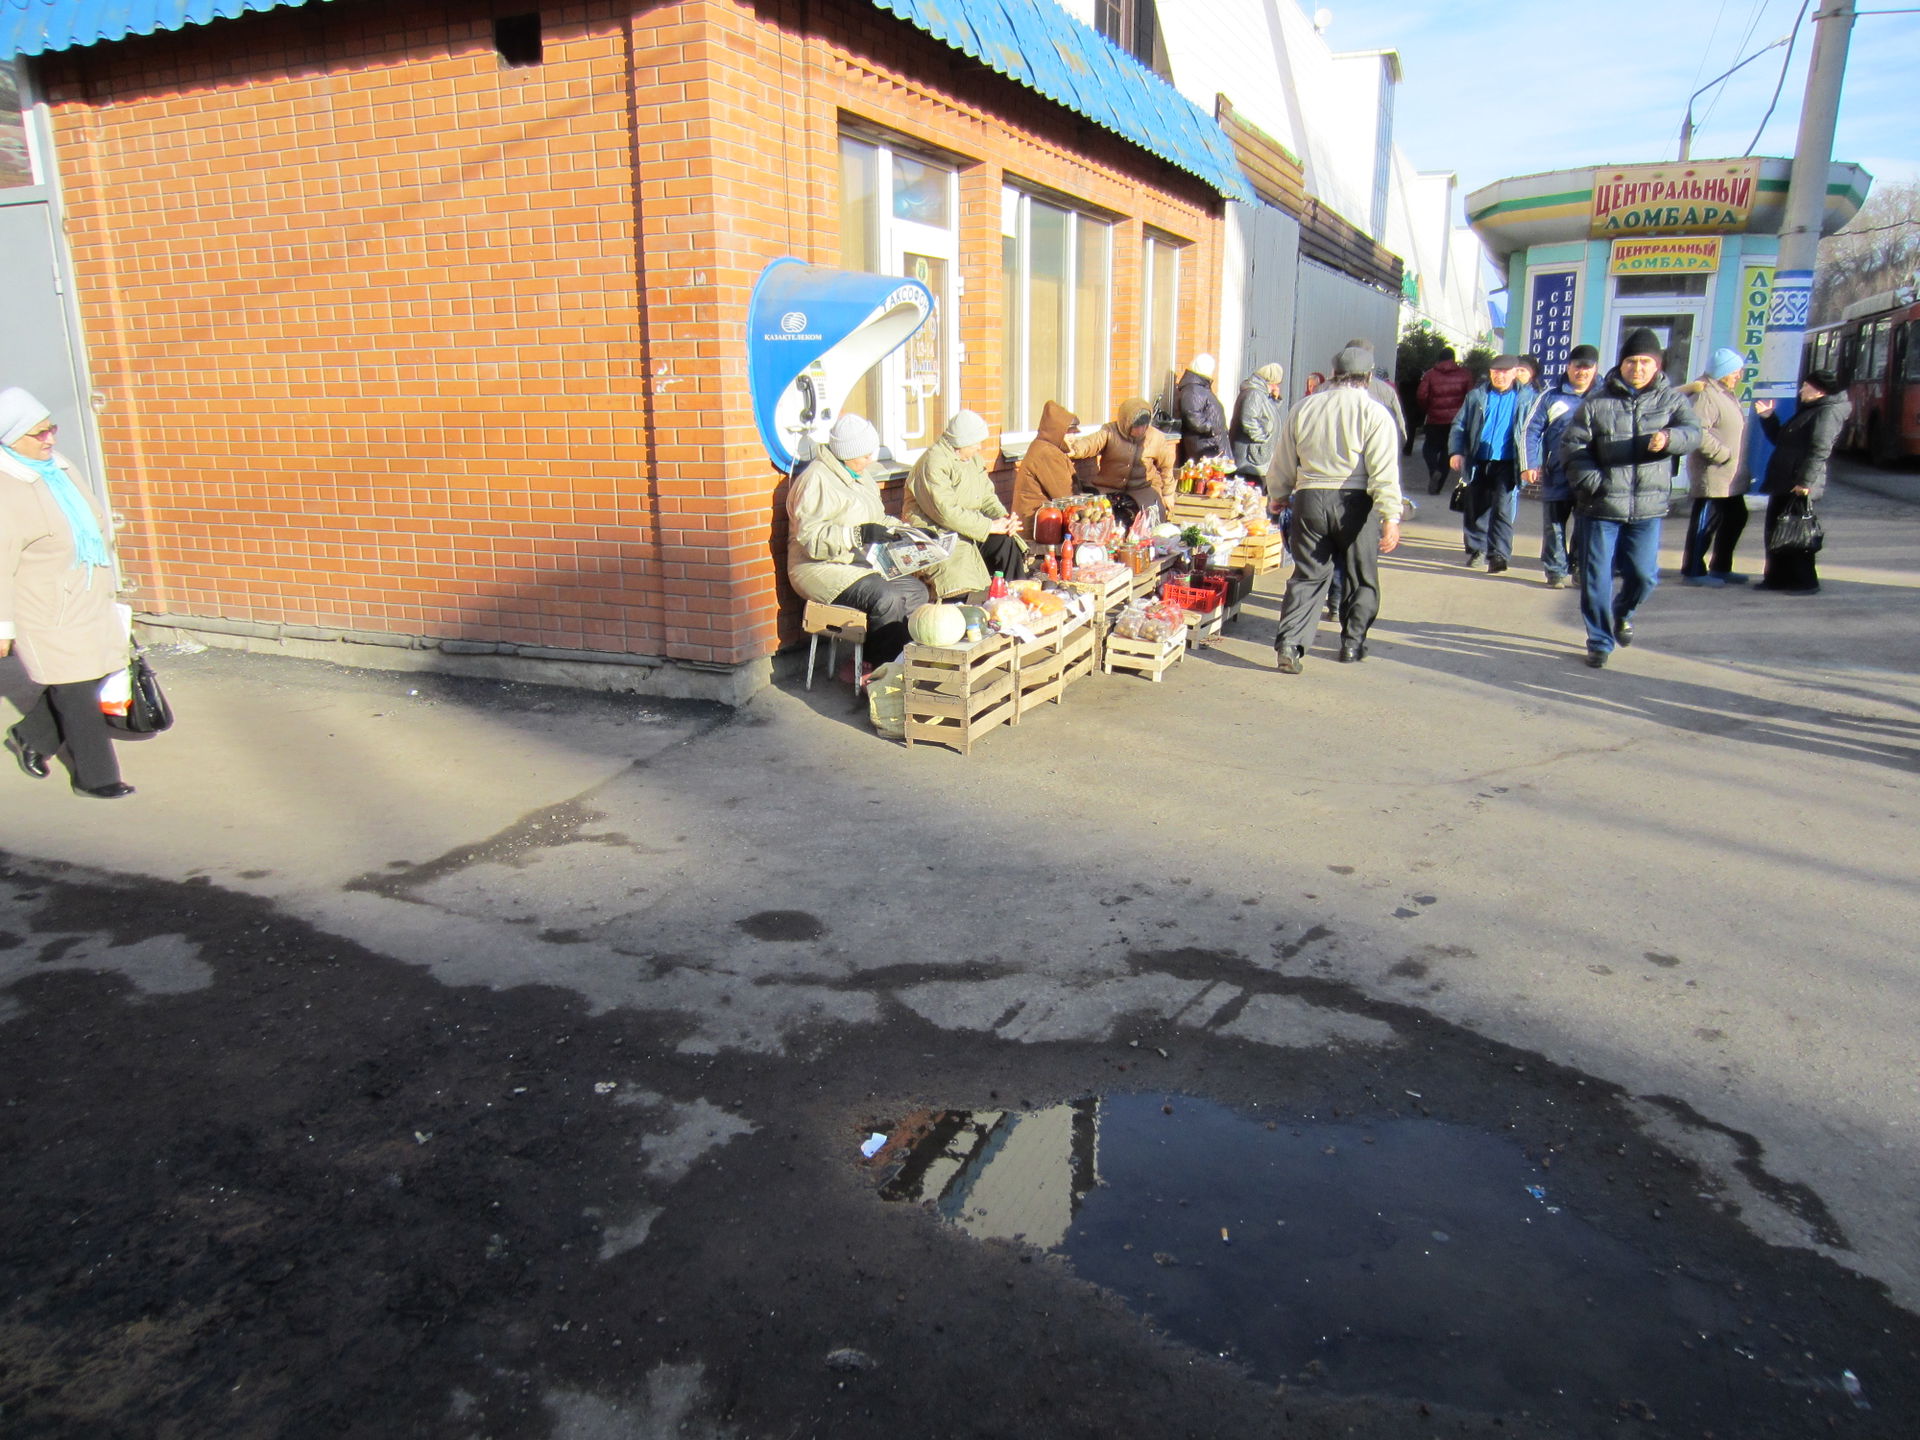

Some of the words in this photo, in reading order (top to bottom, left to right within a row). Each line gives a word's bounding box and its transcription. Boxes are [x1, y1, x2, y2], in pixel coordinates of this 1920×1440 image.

[1596, 168, 1751, 217] ЦЕНТРАЛЬНЫЙ
[1604, 206, 1737, 230] ЛОМБАРД
[1615, 240, 1717, 261] ЦЕНТРАЛЬНЫЙ
[1616, 257, 1712, 270] ЛОМБАРД
[1533, 300, 1544, 363] РЕМО
[1558, 275, 1574, 375] ТЕЛЕФОН
